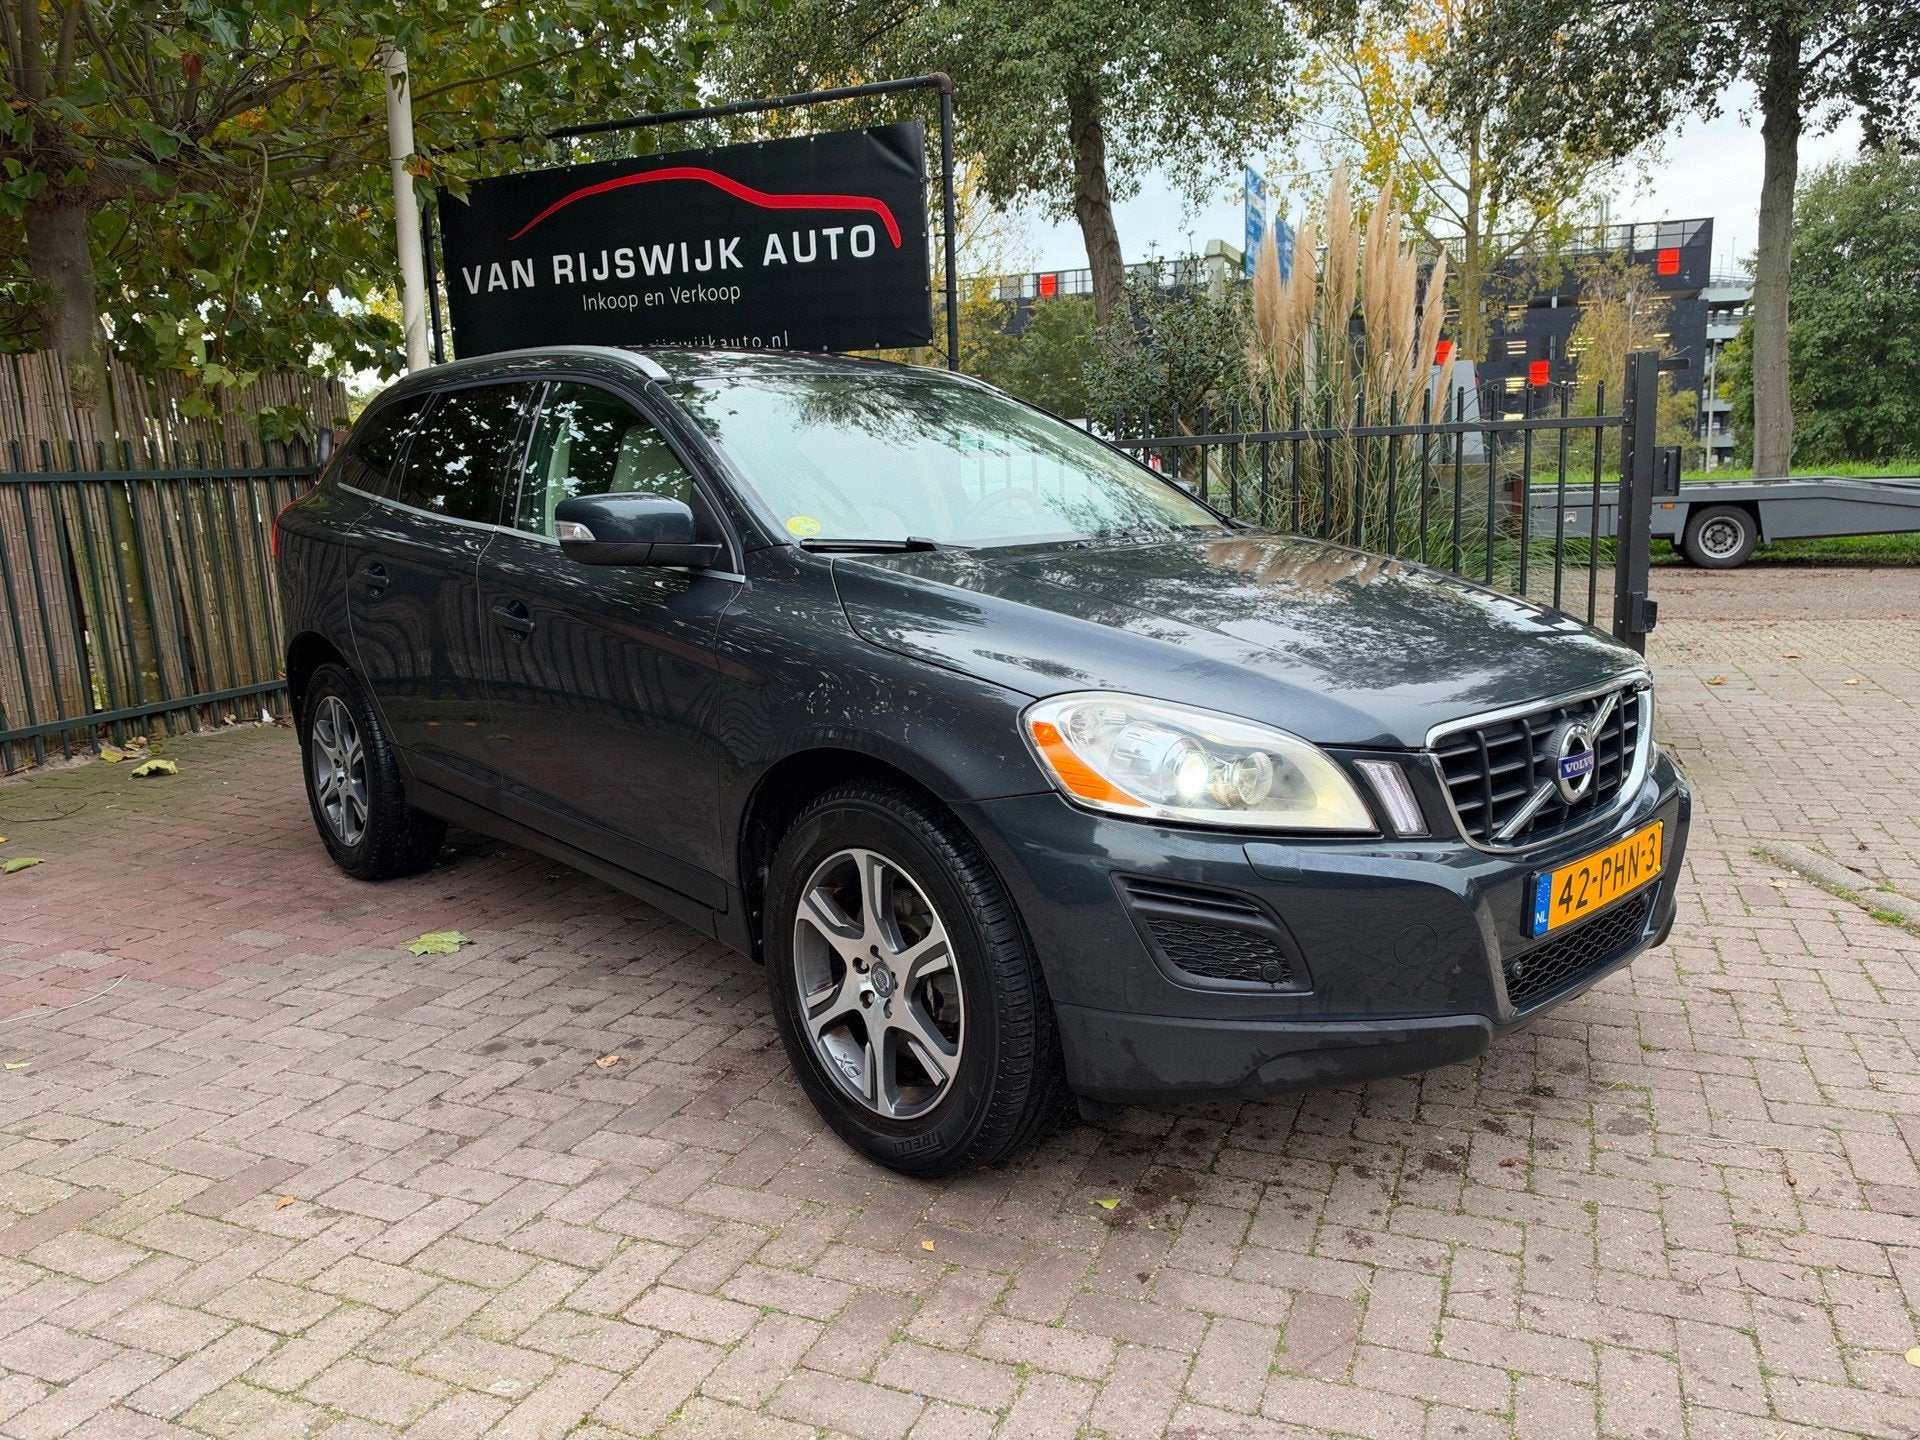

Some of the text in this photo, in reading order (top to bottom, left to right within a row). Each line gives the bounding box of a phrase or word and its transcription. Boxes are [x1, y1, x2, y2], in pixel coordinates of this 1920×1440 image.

[462, 224, 876, 295] VAN RIJSWIJK AUTO
[582, 284, 741, 312] Inkoop en Verkoop
[1563, 755, 1594, 774] VOLVO
[1557, 832, 1657, 915] 42-PHN-3
[1535, 910, 1548, 926] NL
